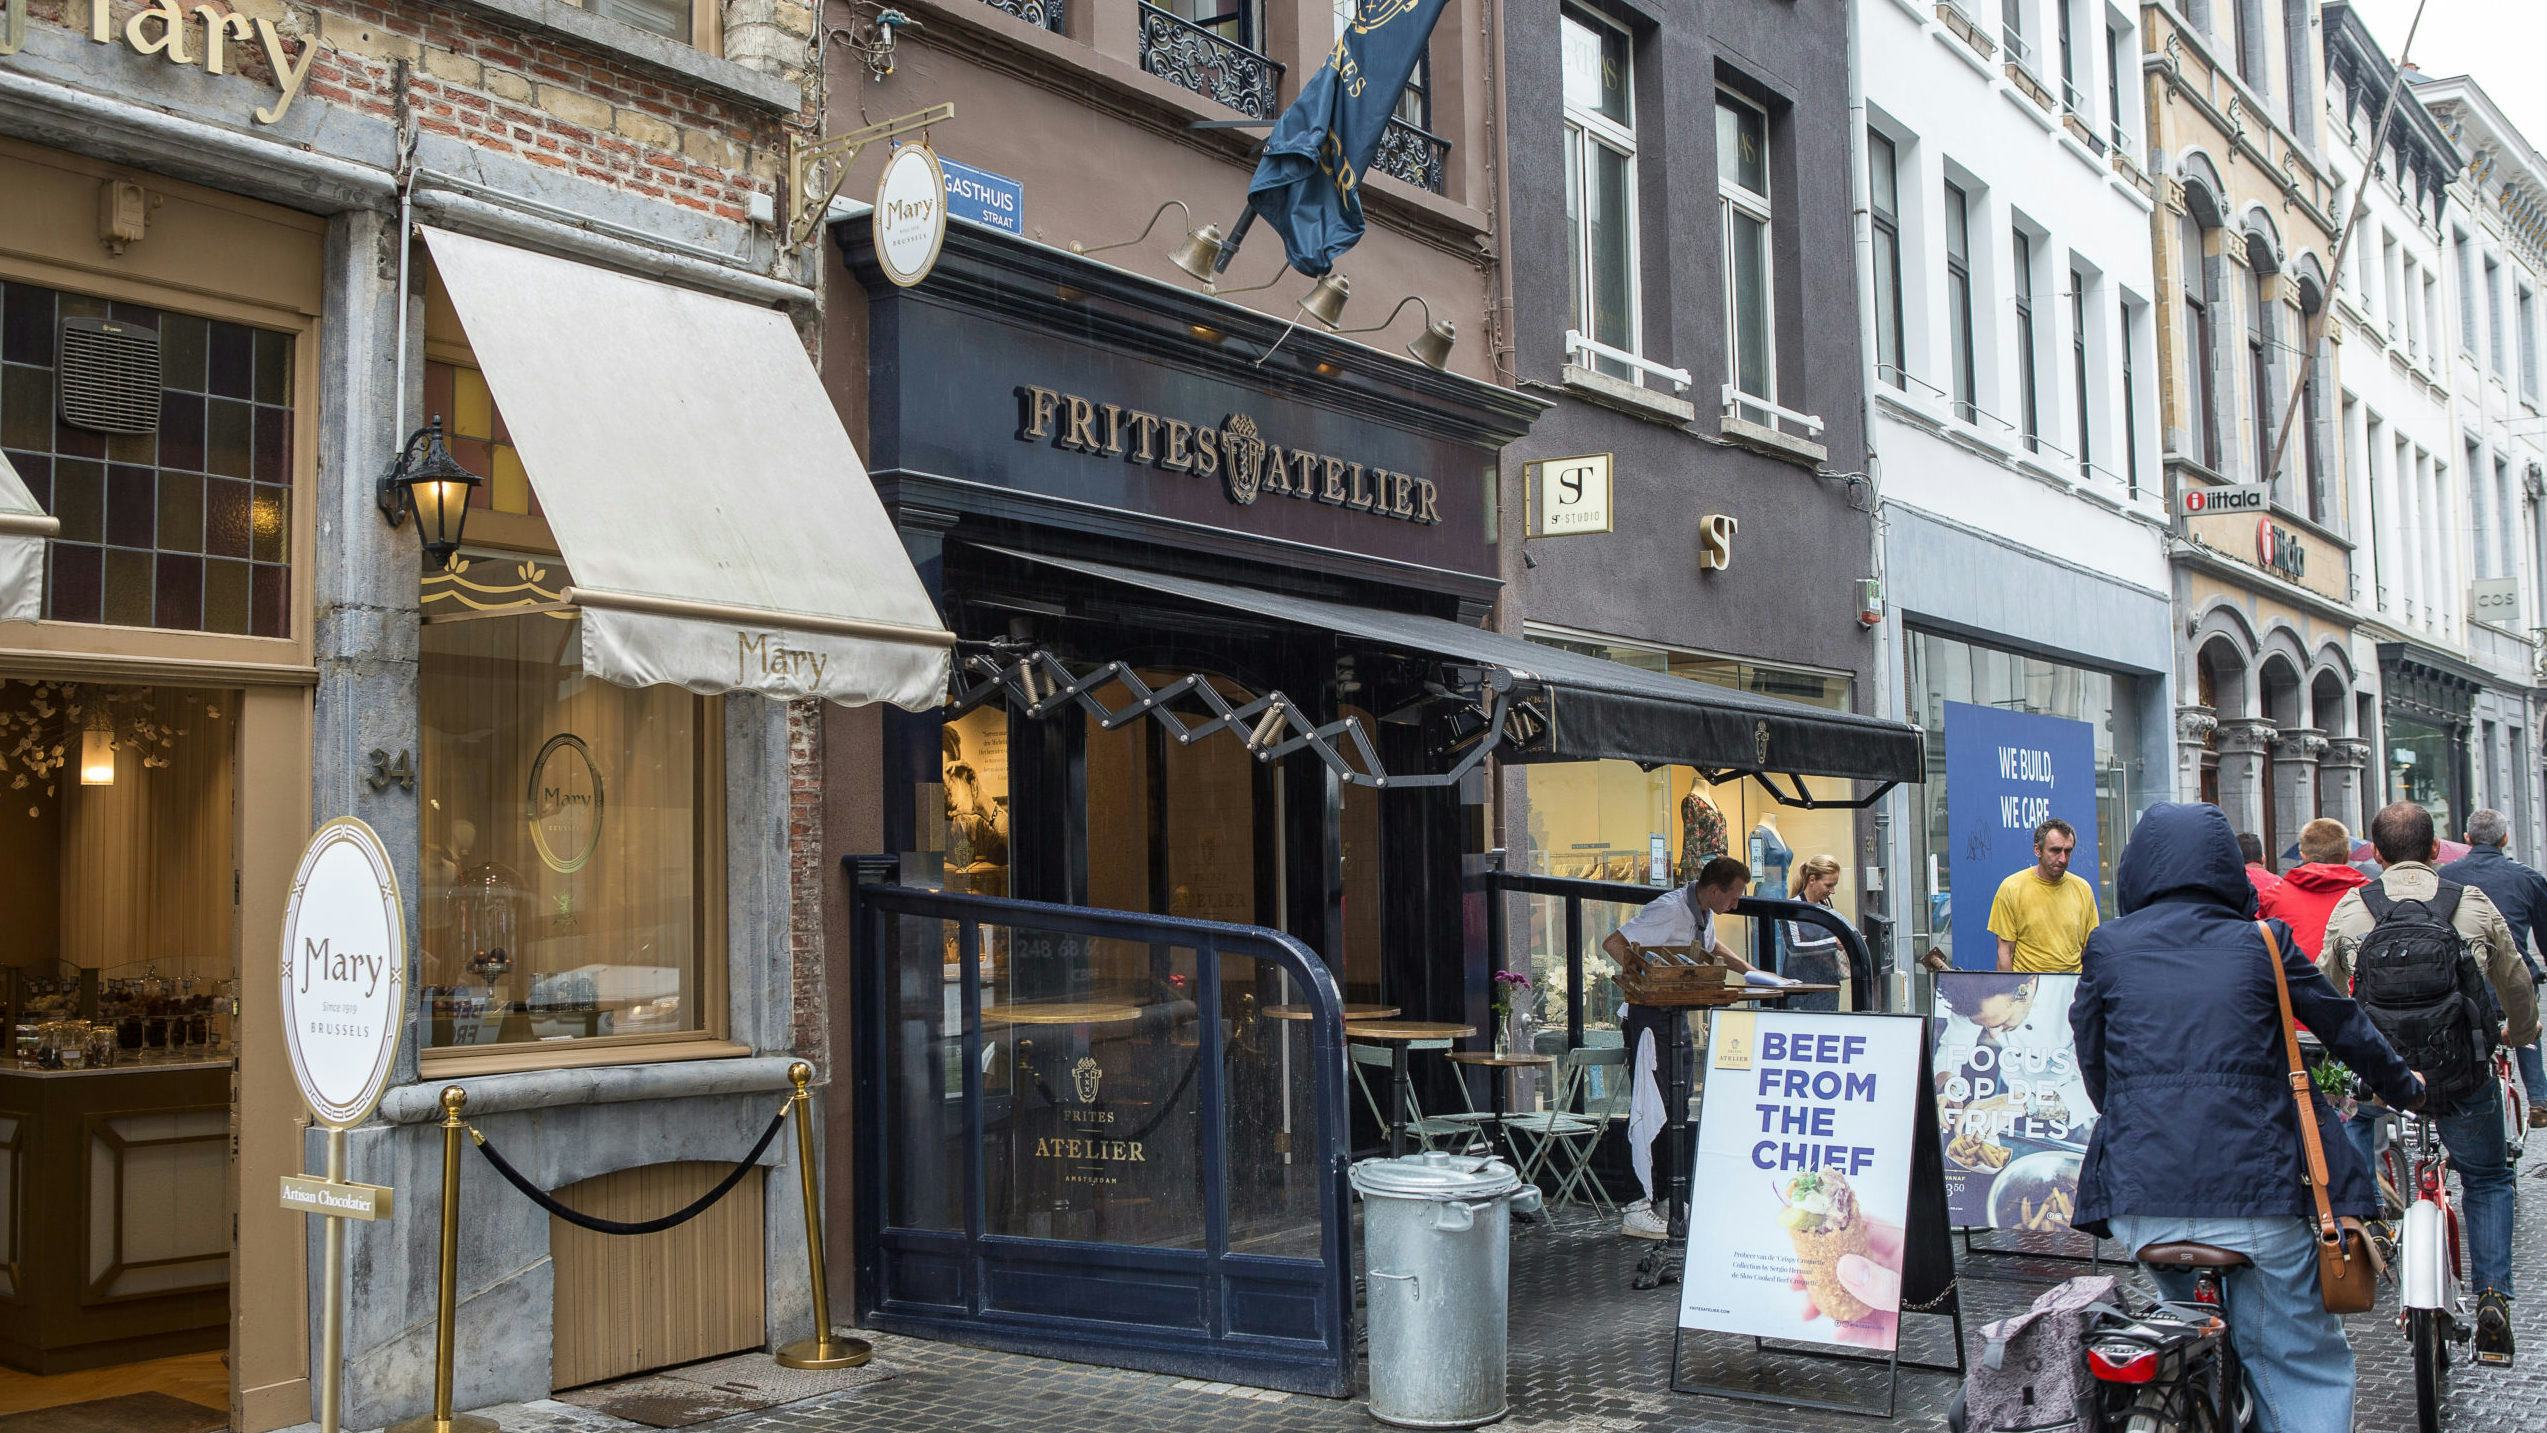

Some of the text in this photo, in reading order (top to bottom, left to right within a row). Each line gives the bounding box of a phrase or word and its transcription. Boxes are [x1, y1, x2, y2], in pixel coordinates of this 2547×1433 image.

[943, 174, 1014, 212] GASTHUIS
[886, 197, 934, 231] Mary
[982, 210, 1014, 229] STRAAT
[1024, 384, 1442, 526] FRITES ATELIER
[2207, 490, 2261, 510] iittala
[1565, 511, 1600, 524] STUDIO
[2478, 592, 2515, 607] COS
[735, 630, 828, 692] Mary
[366, 747, 415, 793] 34
[1998, 746, 2054, 789] WE BUILD,
[544, 787, 592, 809] Mary
[2000, 796, 2050, 830] WE CARE
[301, 937, 383, 998] Mary
[322, 1001, 359, 1015] Since 1919
[310, 1022, 370, 1038] BRUSSELS
[1762, 1032, 1867, 1064] BEEF
[1946, 1043, 2072, 1075] FOCUS
[1758, 1067, 1877, 1102] FROM
[1943, 1076, 2056, 1106] OP DE
[1063, 1110, 1115, 1123] FRITES
[1755, 1103, 1836, 1137] THE
[1942, 1107, 2070, 1140] FRITES
[1035, 1137, 1146, 1161] ATELIER
[1751, 1140, 1876, 1176] CHIEF
[1065, 1175, 1117, 1184] AMSTERDAM
[282, 1185, 372, 1212] Artisan Chocolatier
[1732, 1261, 1761, 1270] Collection
